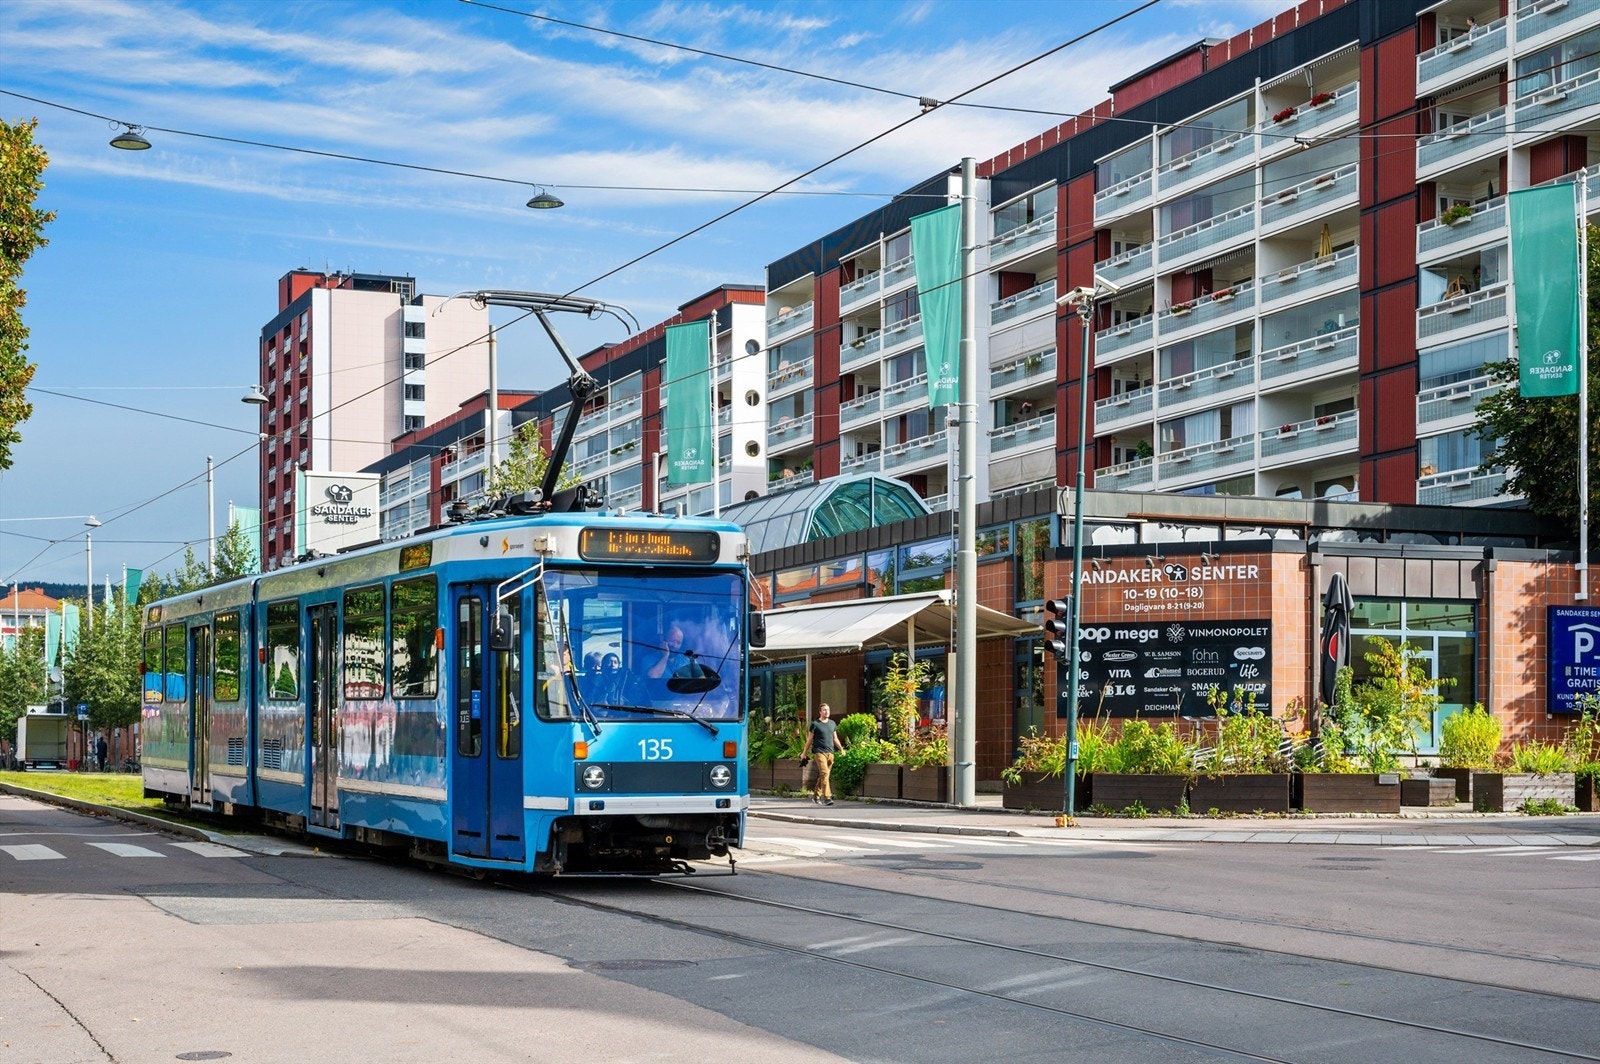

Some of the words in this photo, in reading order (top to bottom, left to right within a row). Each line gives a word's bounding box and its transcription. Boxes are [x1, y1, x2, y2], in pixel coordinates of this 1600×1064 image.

[313, 505, 373, 516] SANDAKER
[327, 514, 360, 523] SENTER
[1191, 565, 1258, 581] SENTER
[1123, 588, 1157, 600] 10-19
[1160, 587, 1203, 599] (10-18)
[1124, 603, 1165, 613] Dagligvare
[1556, 609, 1590, 617] SANDAKER
[1115, 629, 1159, 643] mega
[1188, 627, 1268, 637] VINMONOPOLET
[1574, 631, 1594, 663] P
[1108, 669, 1132, 678] VITA
[1186, 668, 1225, 676] BOGERUD
[1574, 667, 1597, 676] TIME
[1104, 685, 1137, 696] BLG
[1191, 683, 1220, 691] SNASK
[638, 738, 673, 760] 135
